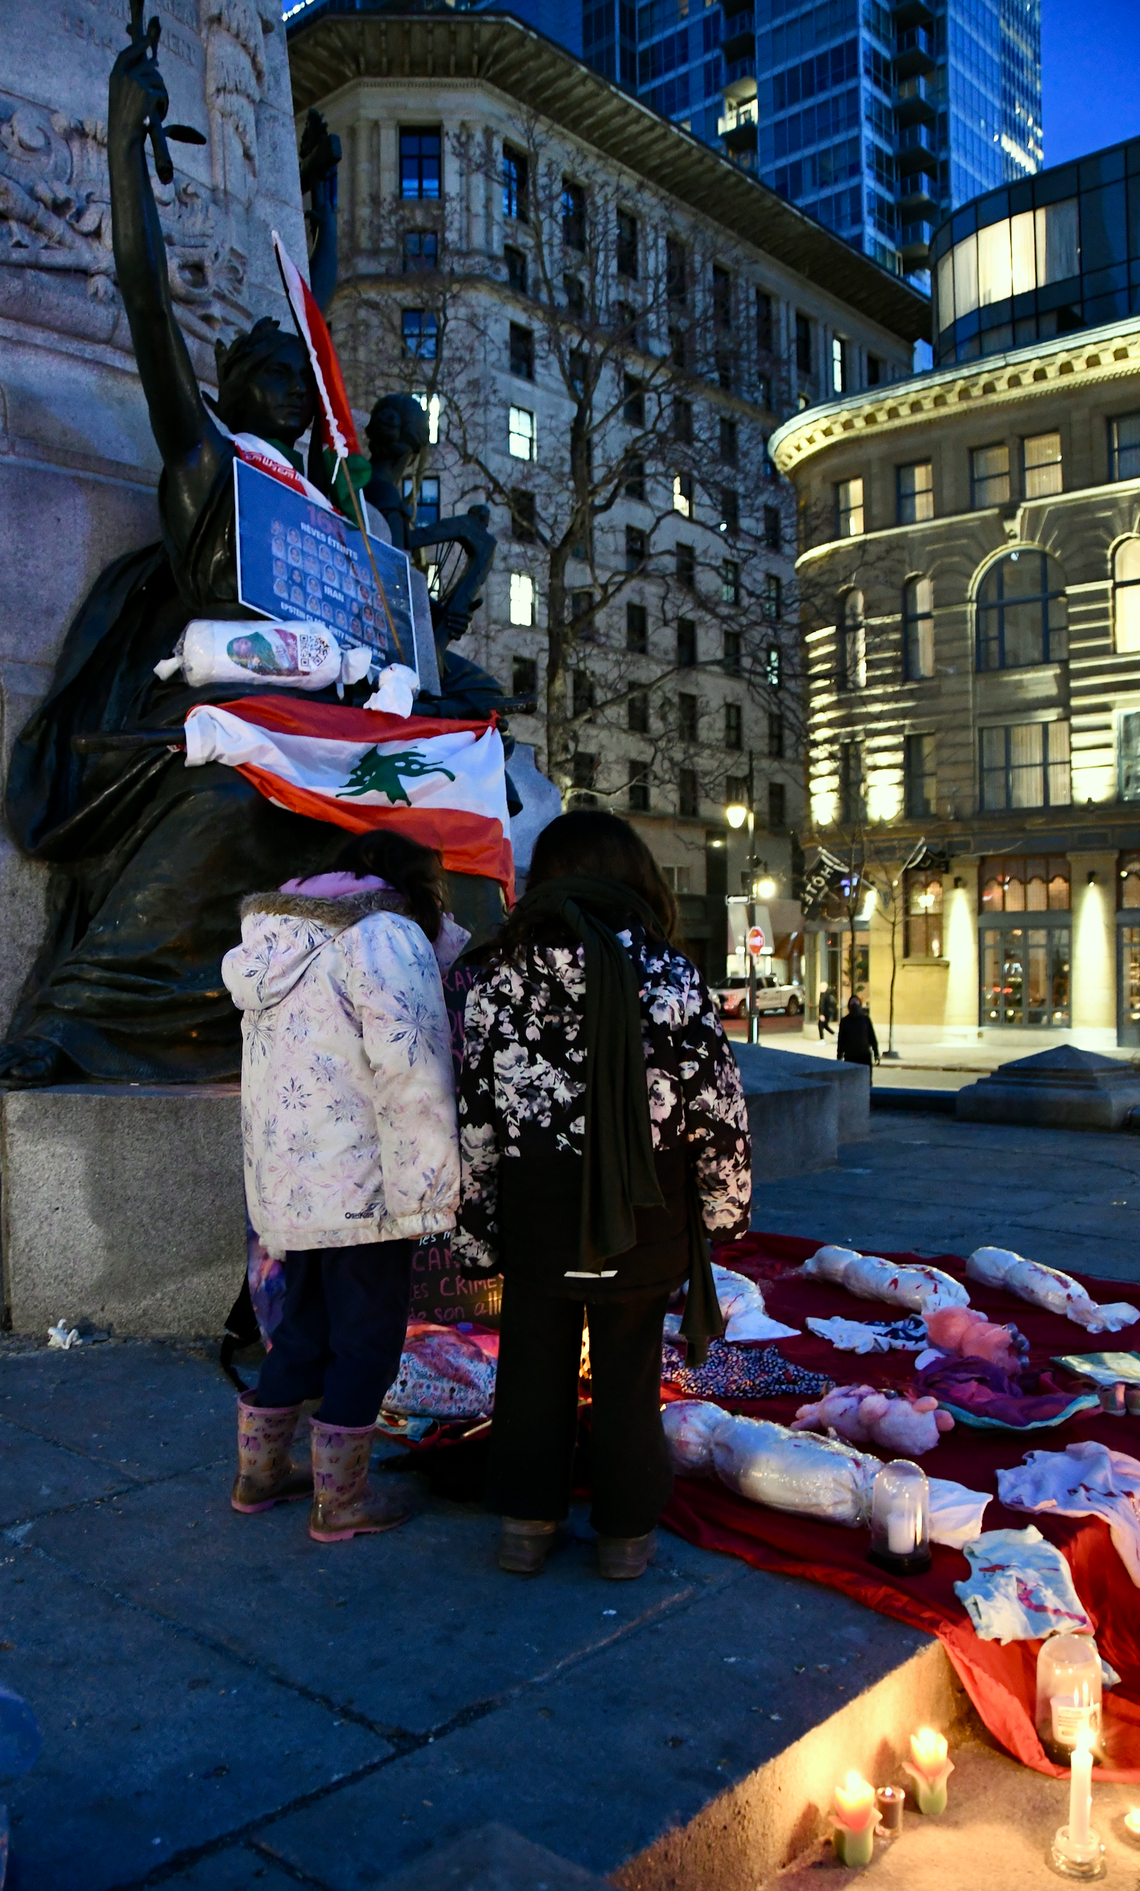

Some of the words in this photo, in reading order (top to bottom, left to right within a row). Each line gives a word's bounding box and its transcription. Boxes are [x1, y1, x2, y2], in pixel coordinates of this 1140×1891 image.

[300, 521, 327, 544] RÊVES
[324, 585, 345, 603] IRAN
[433, 1304, 465, 1324] son
